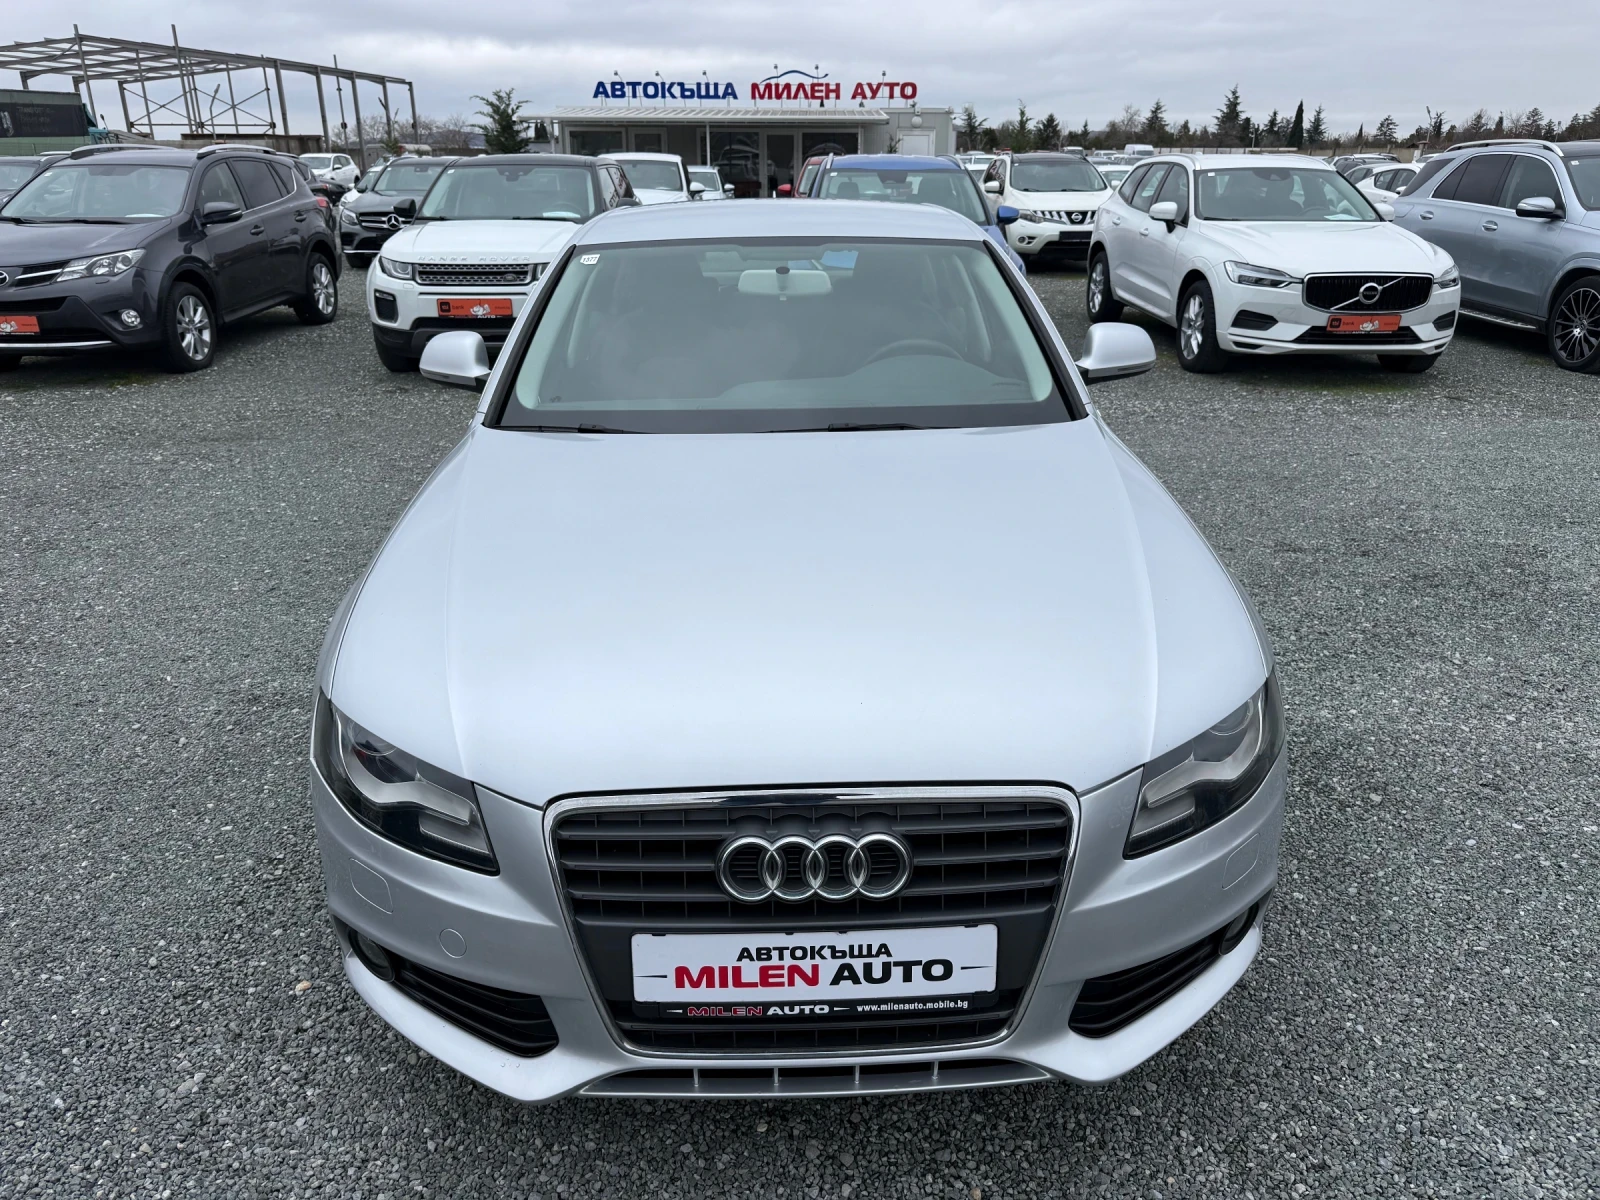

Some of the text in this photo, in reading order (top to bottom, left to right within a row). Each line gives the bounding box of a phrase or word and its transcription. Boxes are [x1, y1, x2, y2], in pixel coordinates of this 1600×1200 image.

[751, 82, 841, 100] МИЛЕН
[851, 82, 918, 100] АУТО
[675, 958, 954, 989] MILEN AUTO
[687, 1000, 969, 1017] MILEN AUTO www.milenauto.mobile.bg
